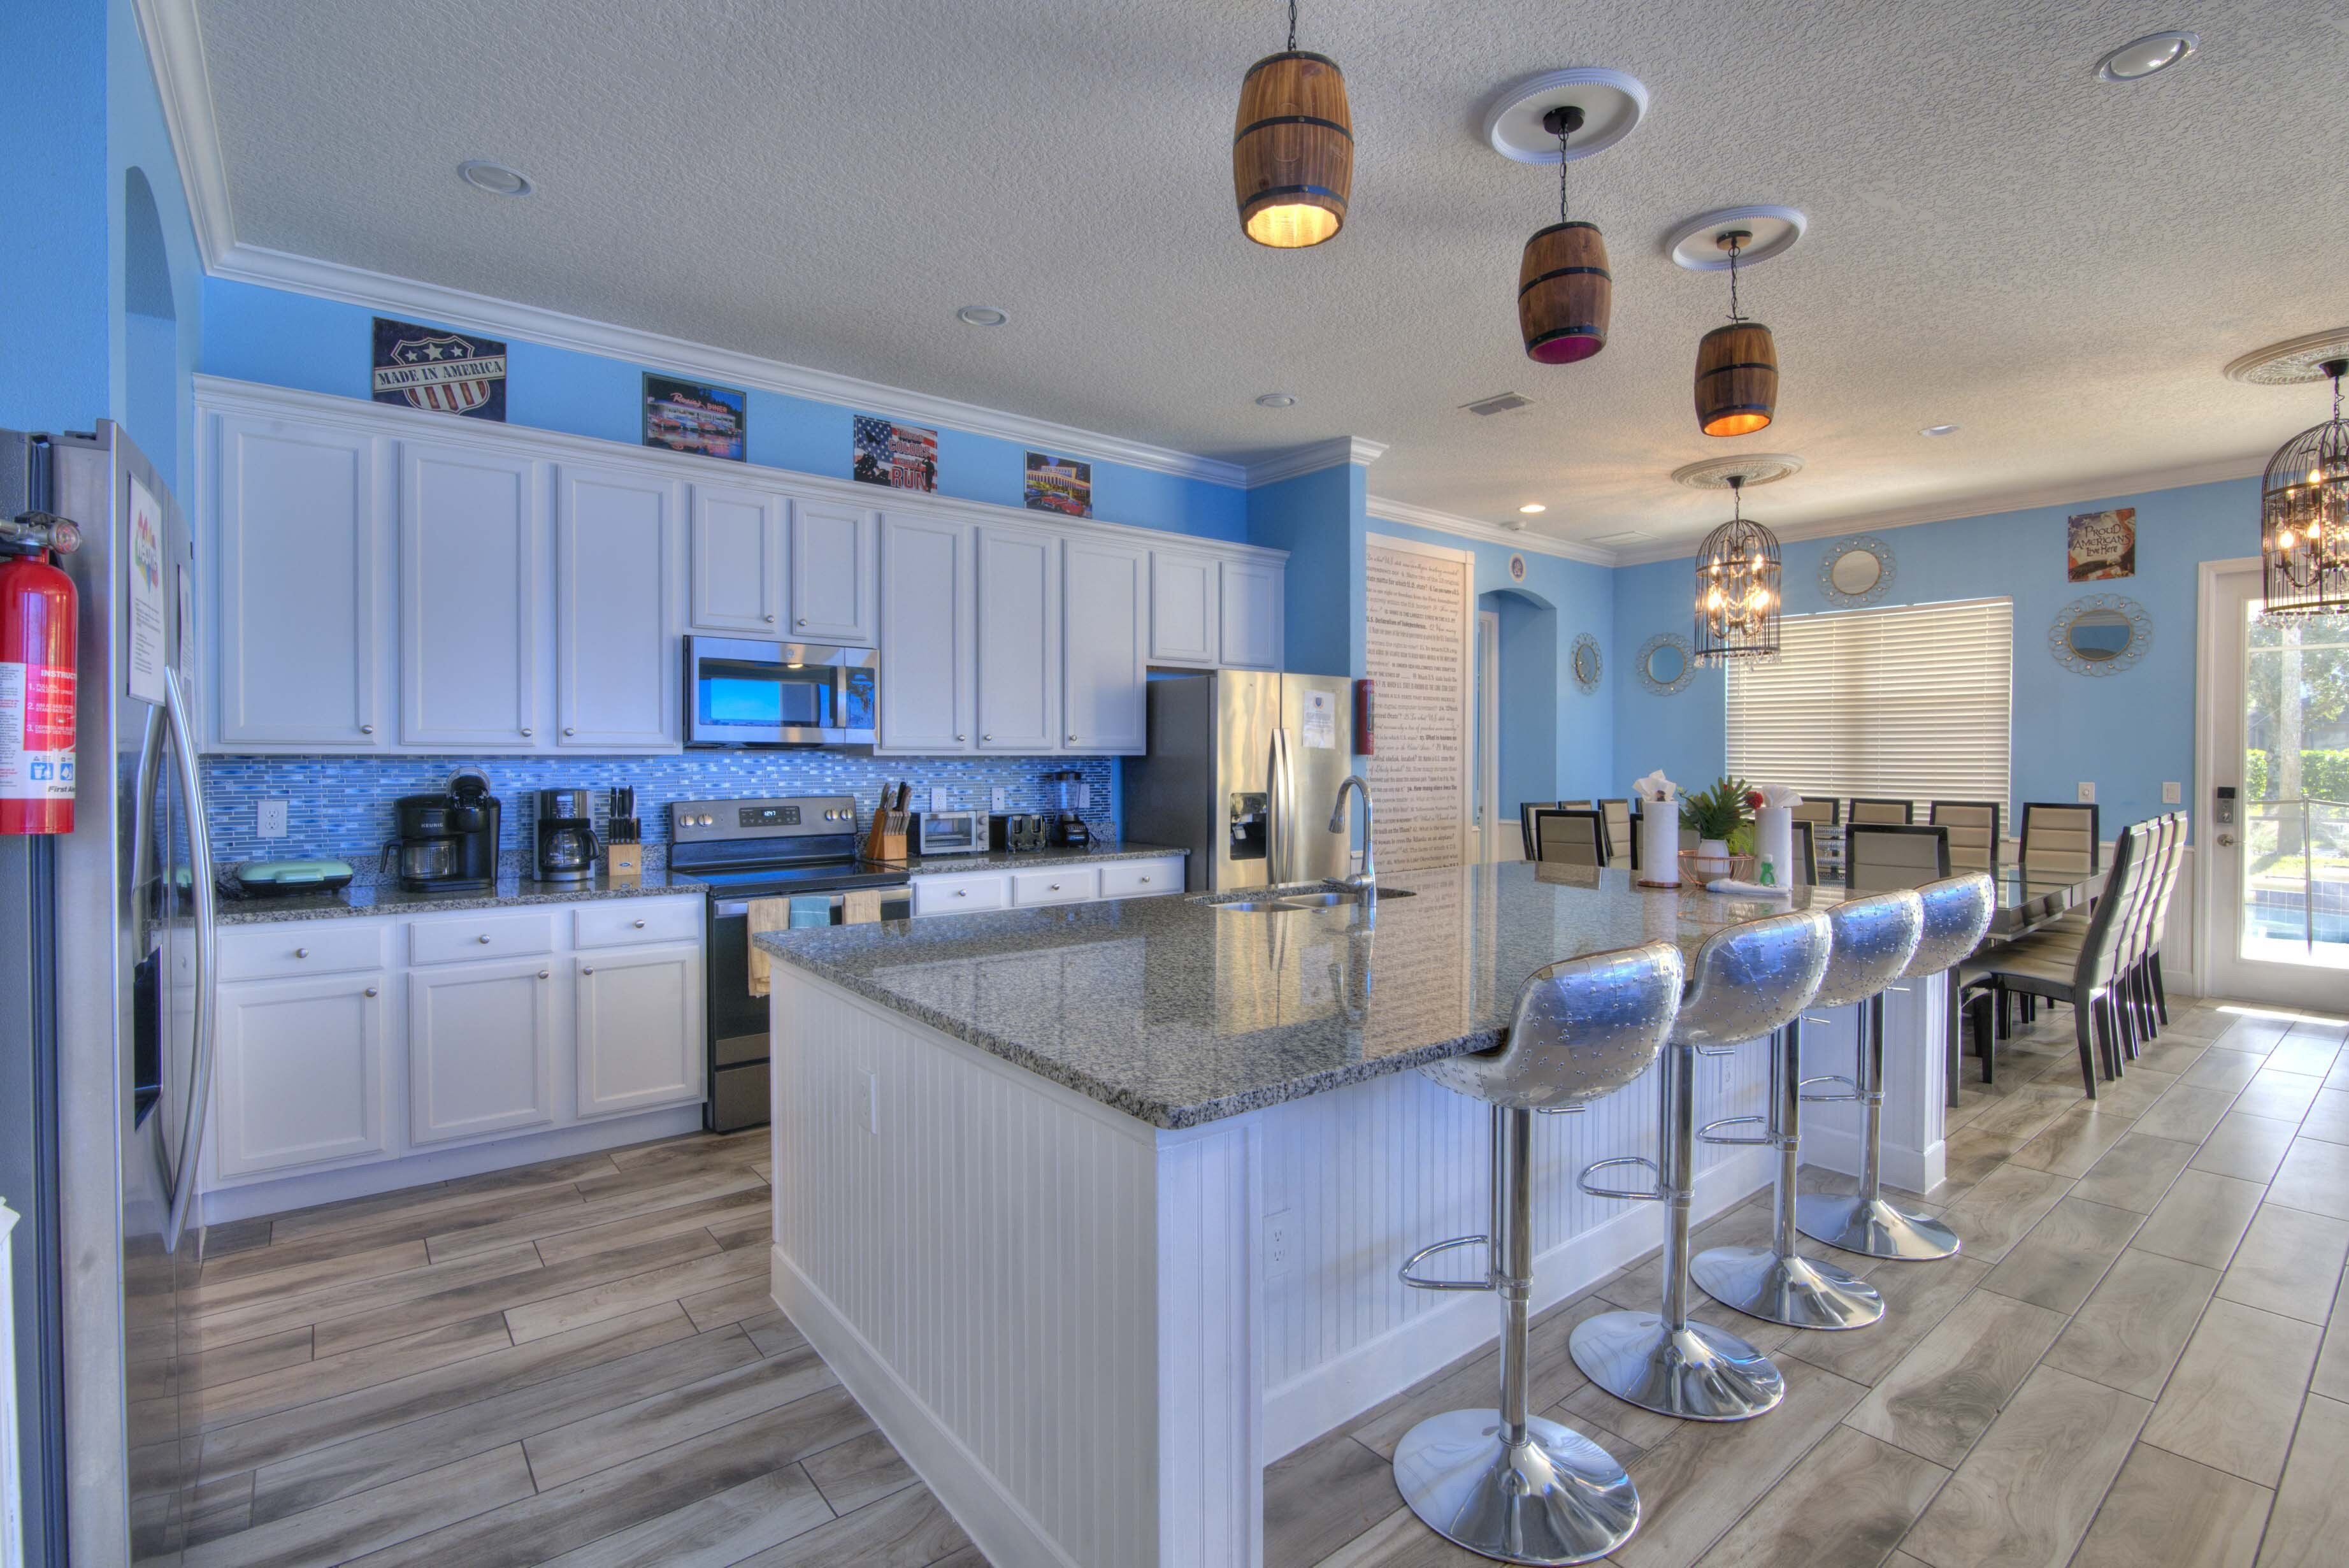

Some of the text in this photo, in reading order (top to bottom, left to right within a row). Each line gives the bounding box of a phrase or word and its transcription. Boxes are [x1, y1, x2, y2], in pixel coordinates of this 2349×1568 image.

[377, 361, 503, 385] MADE IN AMERICA
[888, 438, 930, 457] COLORS
[891, 467, 928, 491] RUN
[2085, 524, 2121, 539] PROUD
[2072, 534, 2131, 550] AMERICANS
